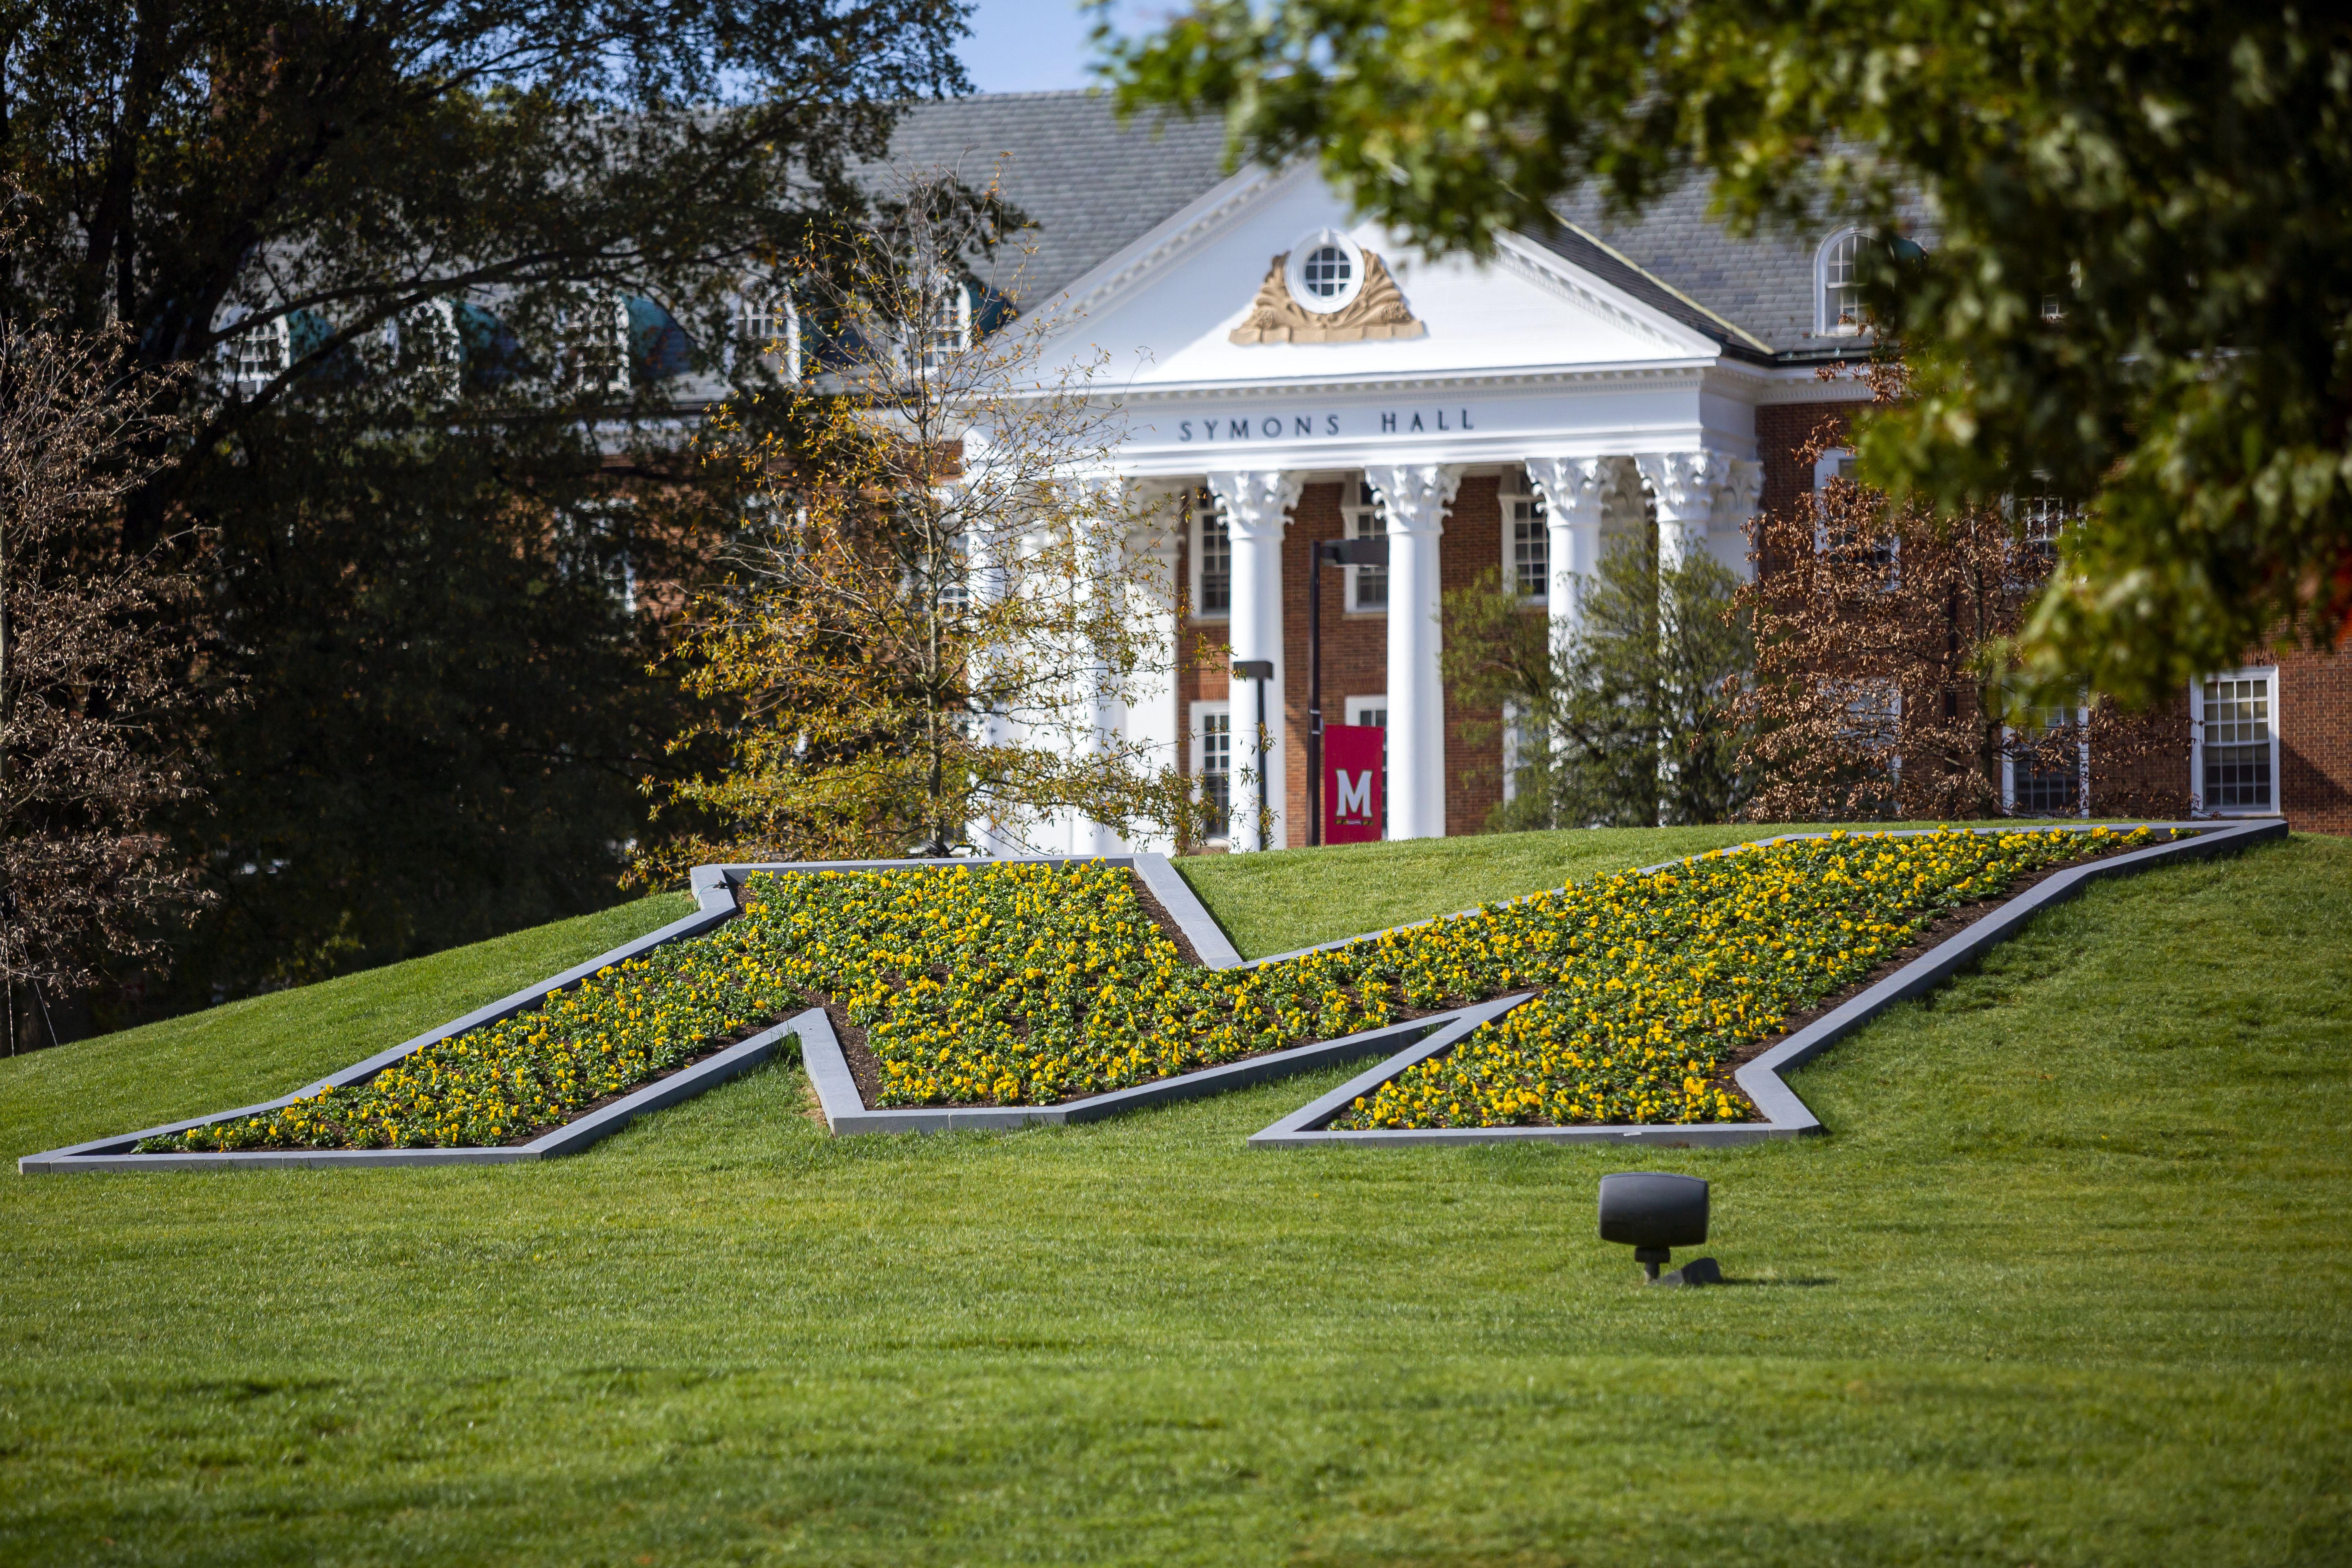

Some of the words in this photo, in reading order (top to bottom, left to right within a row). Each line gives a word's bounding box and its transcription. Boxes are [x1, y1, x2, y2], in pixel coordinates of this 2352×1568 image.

[1178, 413, 1339, 442] SYMONS
[1381, 408, 1474, 434] HALL
[1335, 768, 1374, 817] M
